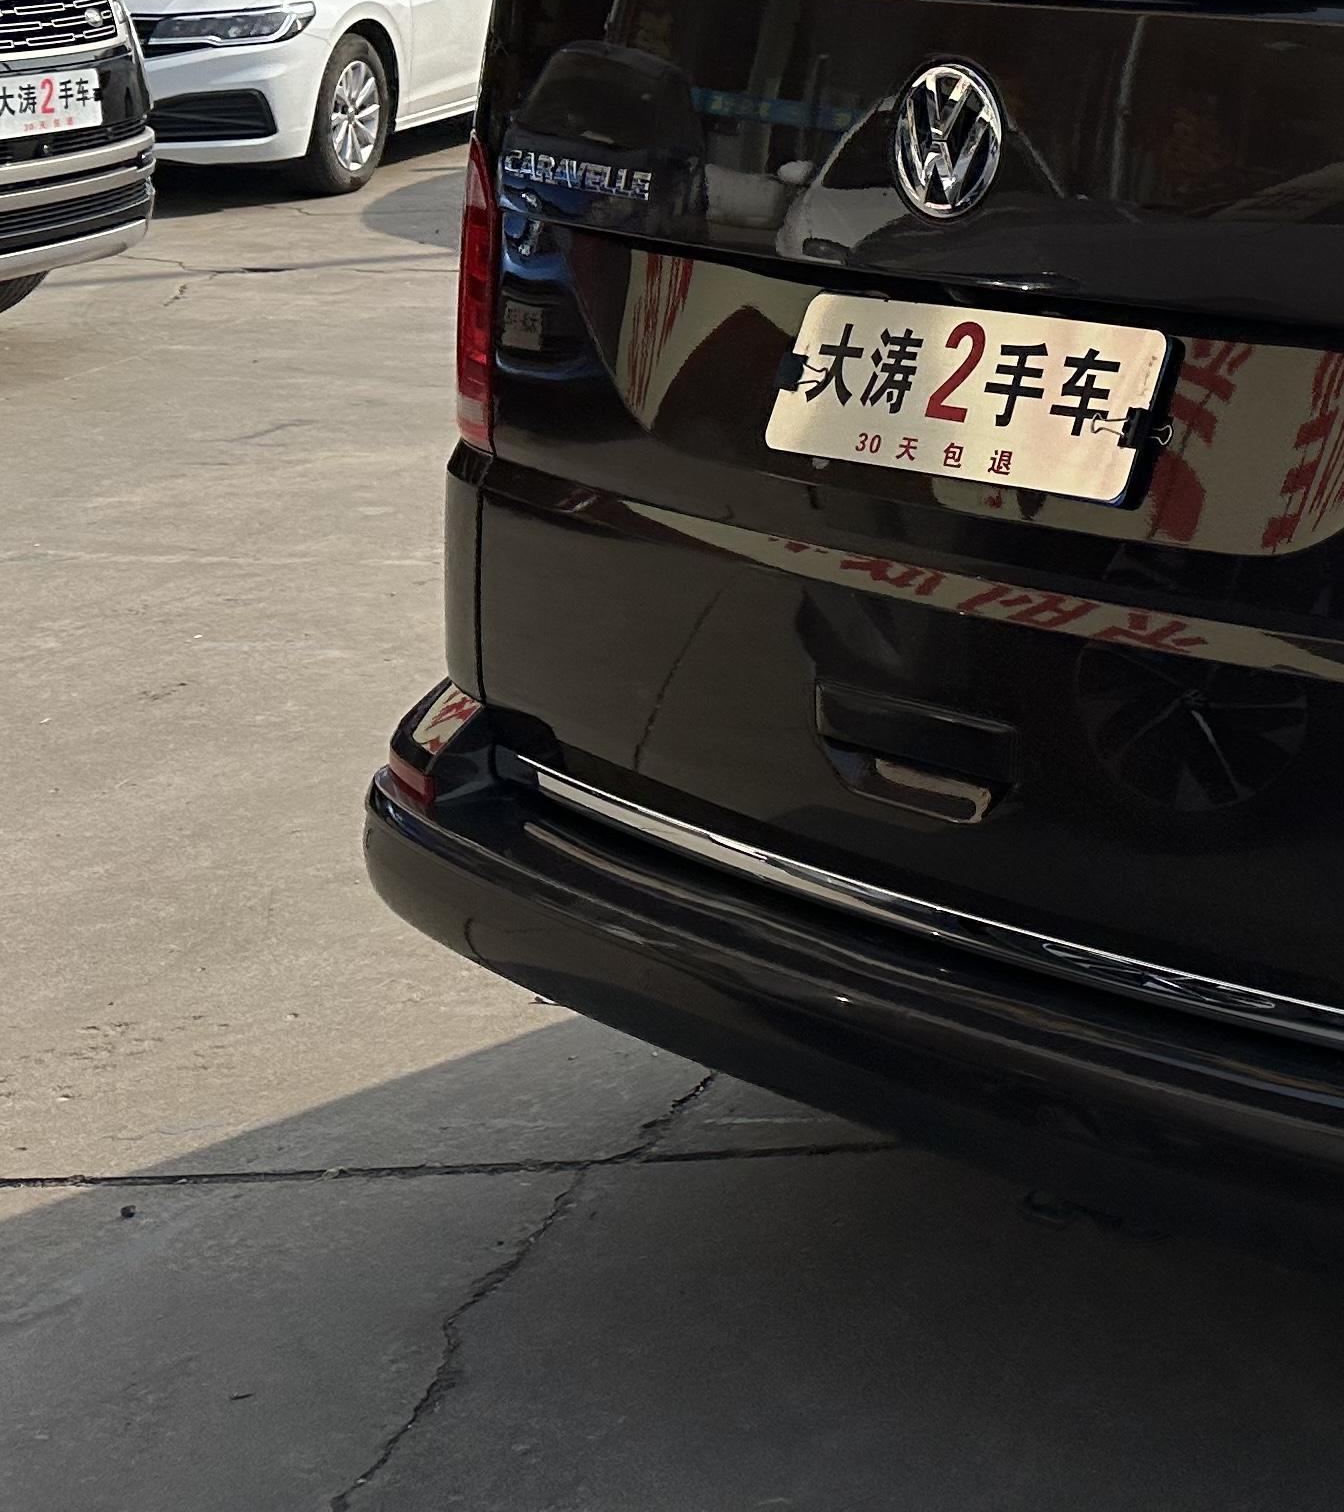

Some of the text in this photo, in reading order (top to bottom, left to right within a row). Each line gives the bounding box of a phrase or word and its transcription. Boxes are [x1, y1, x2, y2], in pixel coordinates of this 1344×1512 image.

[804, 321, 1122, 437] 大涛2手车
[855, 432, 1014, 476] 30天包退
